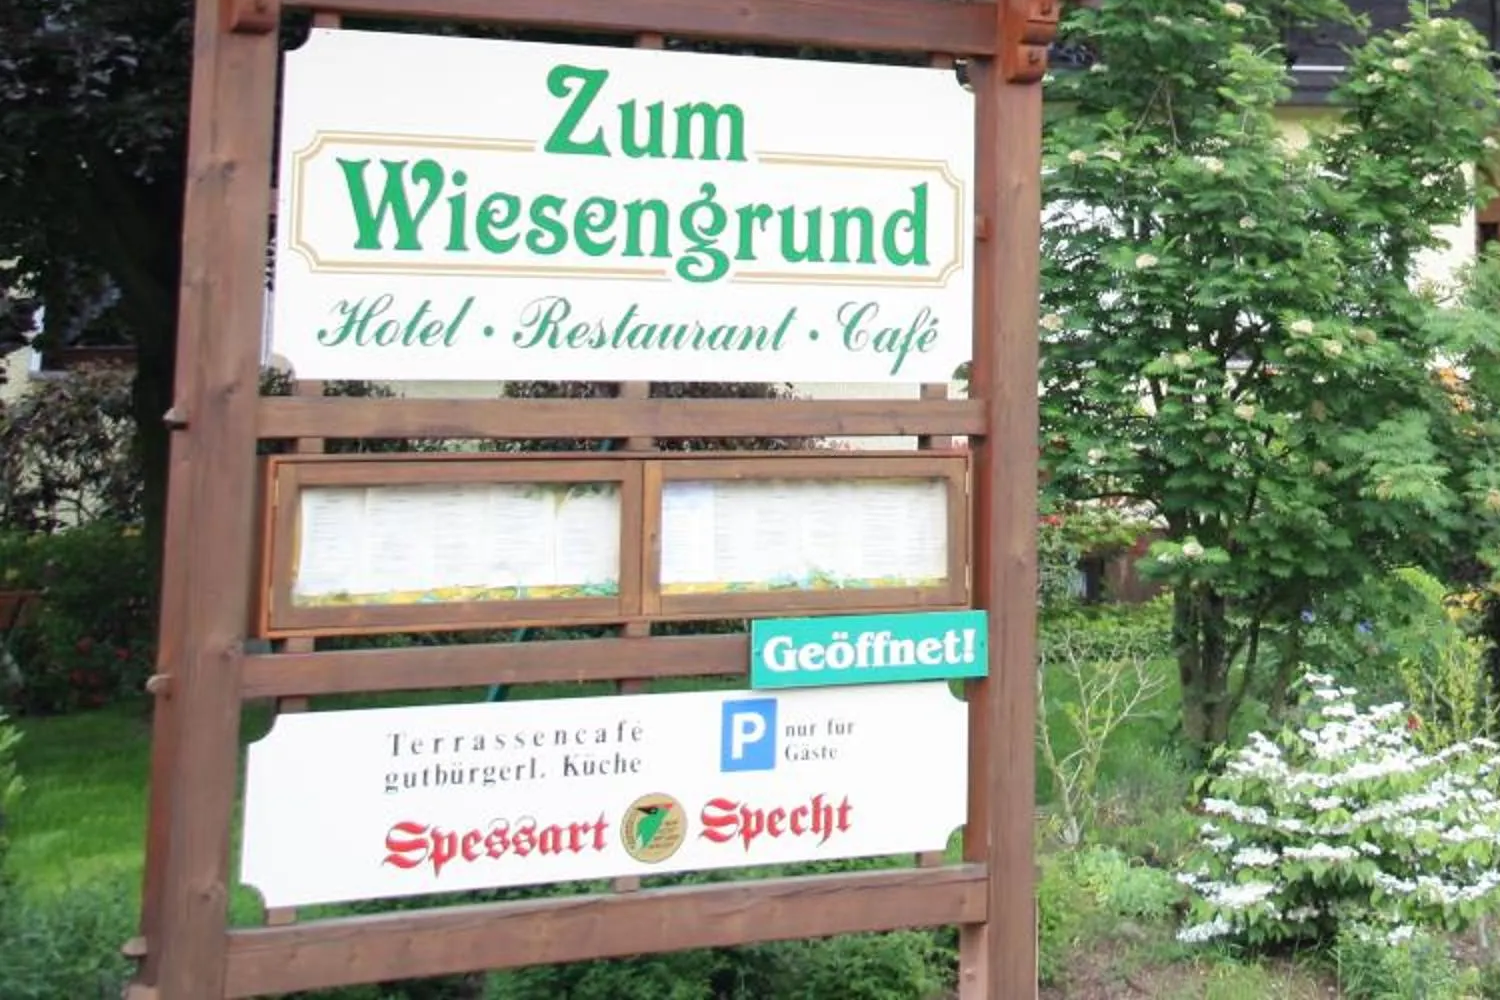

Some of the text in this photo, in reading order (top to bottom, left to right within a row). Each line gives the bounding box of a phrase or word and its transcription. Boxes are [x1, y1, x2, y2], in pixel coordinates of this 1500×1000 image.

[543, 63, 748, 162] Zum
[335, 157, 931, 283] Wiesengrund
[316, 293, 940, 376] Hotel Restaurant Café
[763, 628, 977, 672] Geöffnet!
[387, 719, 644, 757] Terrassencafé
[731, 711, 767, 760] P
[784, 744, 839, 763] Gäste
[785, 724, 816, 738] nur
[384, 751, 643, 794] gutbürgerl. Küche
[381, 812, 610, 878] Spessart
[698, 793, 854, 852] Specht
